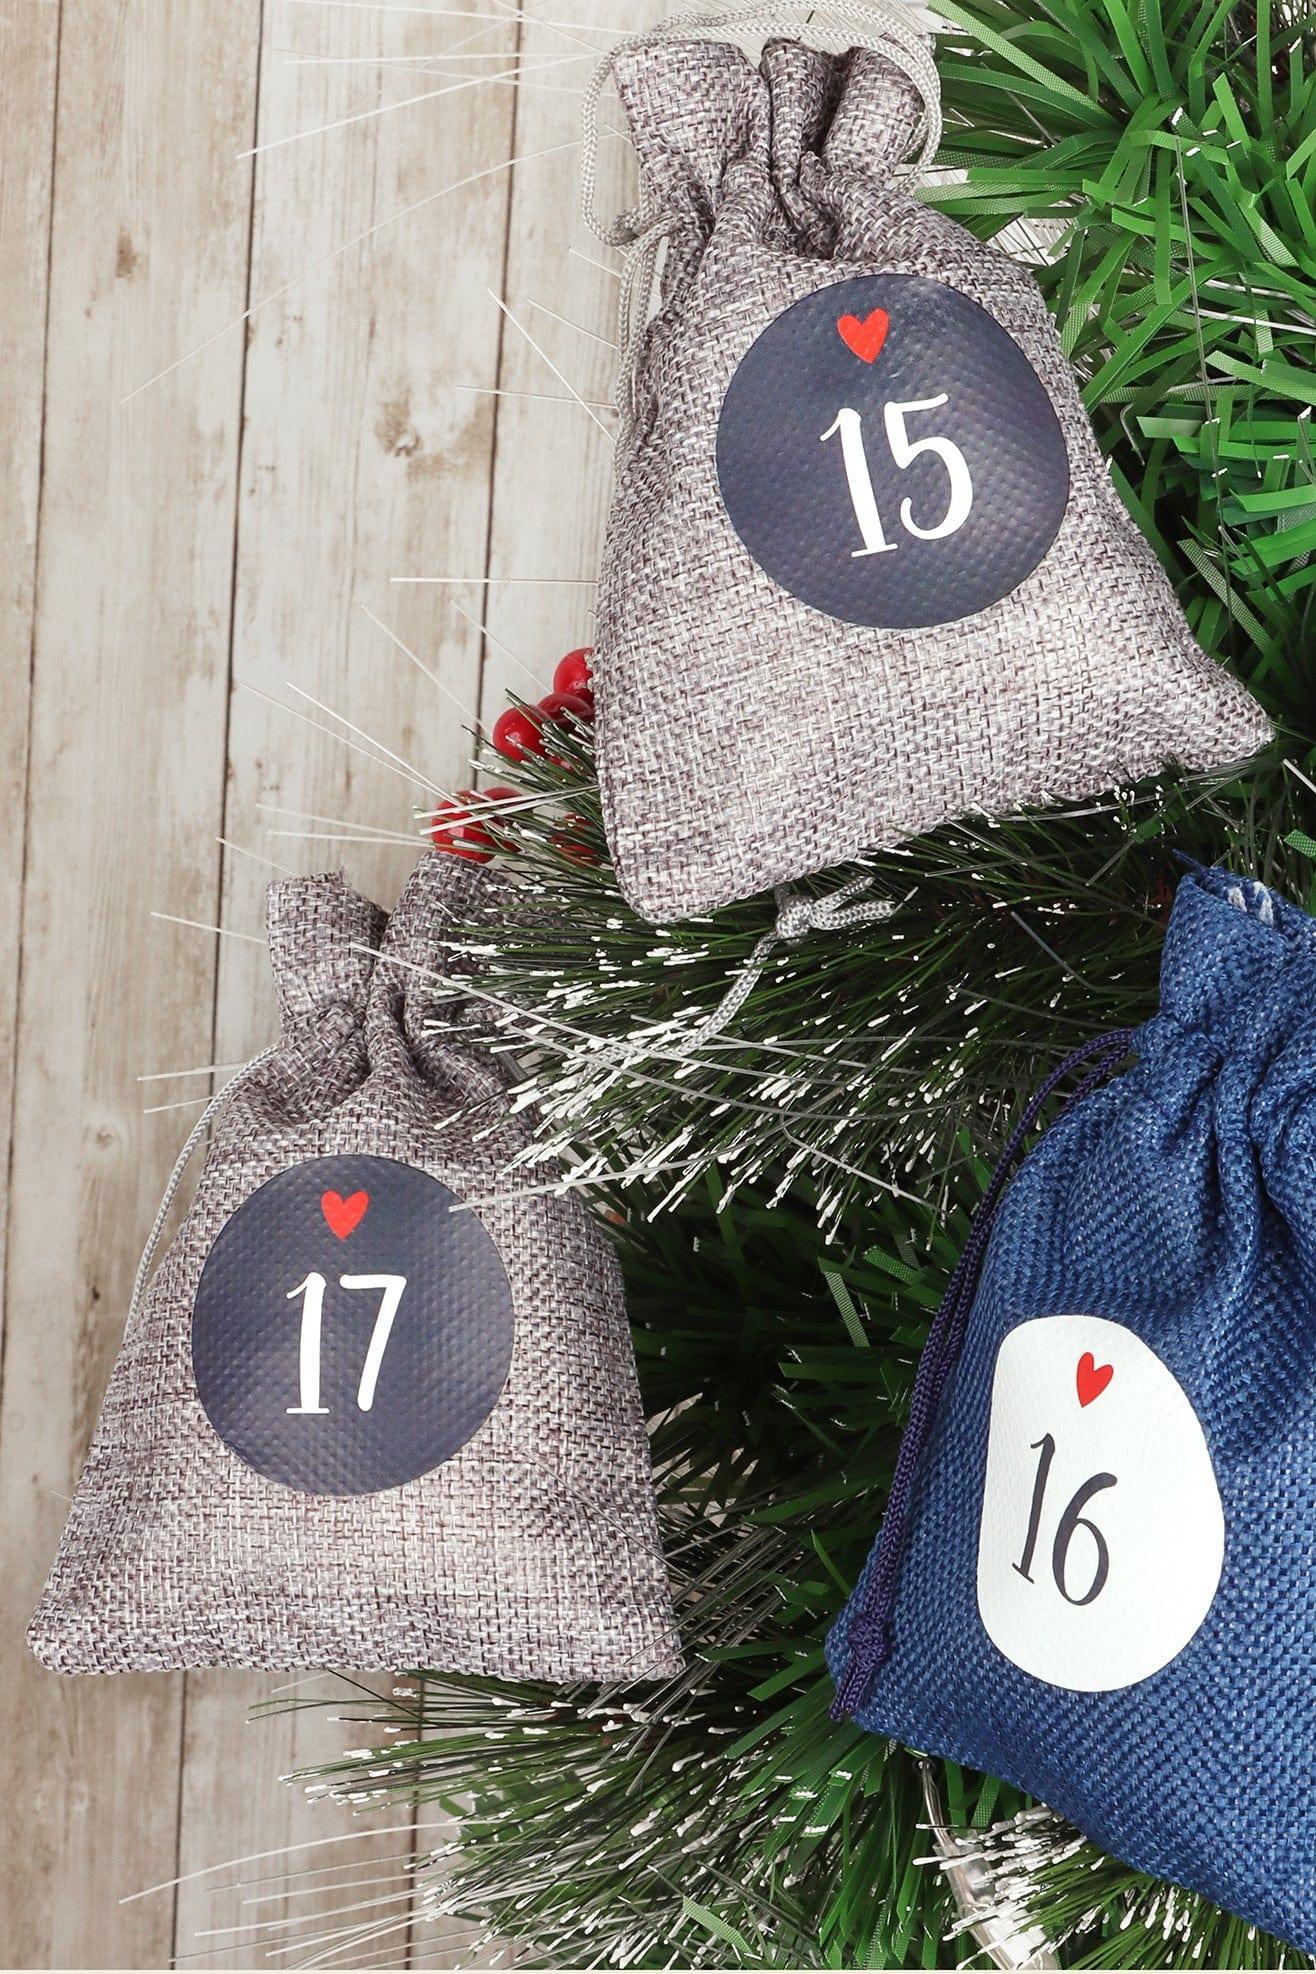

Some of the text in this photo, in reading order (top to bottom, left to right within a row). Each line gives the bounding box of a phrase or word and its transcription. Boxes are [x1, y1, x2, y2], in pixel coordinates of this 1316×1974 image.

[819, 392, 974, 558] 15
[285, 1272, 408, 1417] 17
[1011, 1432, 1118, 1607] 16
